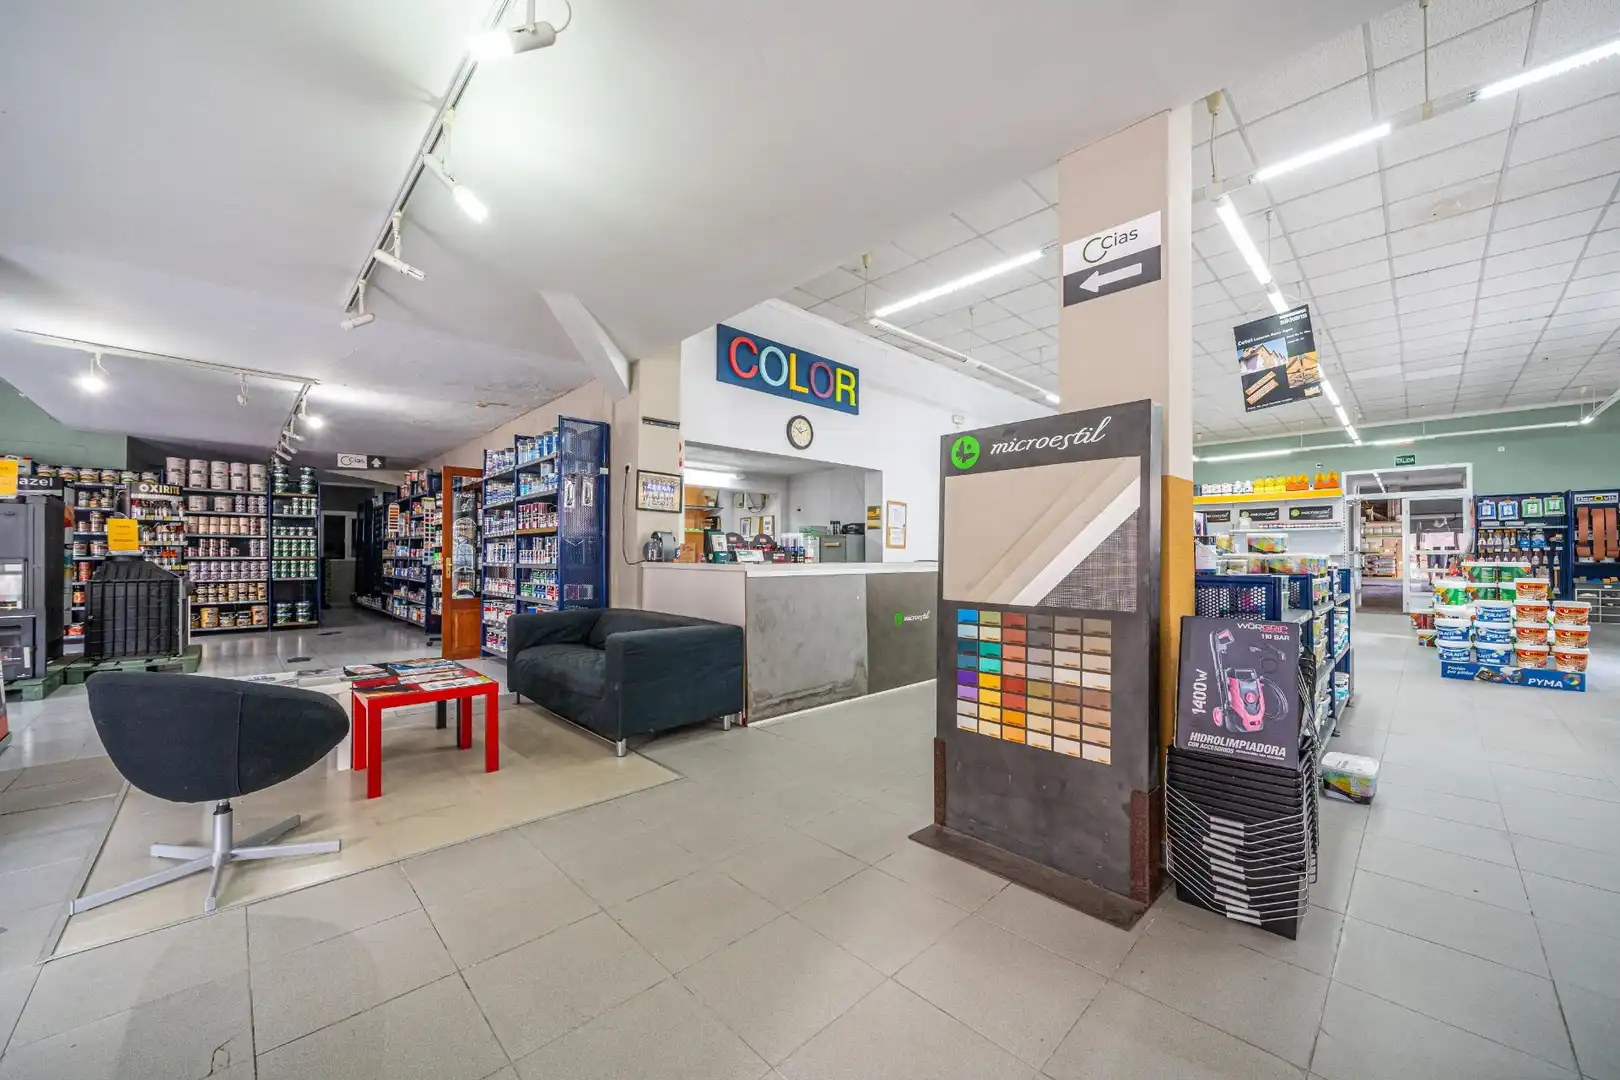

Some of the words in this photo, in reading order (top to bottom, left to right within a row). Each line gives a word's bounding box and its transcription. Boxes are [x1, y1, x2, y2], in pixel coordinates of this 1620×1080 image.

[728, 336, 857, 407] COLOR
[990, 416, 1112, 455] microestil
[16, 477, 53, 487] azel
[139, 483, 180, 495] OXIRITE
[1528, 678, 1563, 688] PYMA
[1189, 731, 1286, 757] HIDROLIMPIADORA
[1200, 743, 1234, 754] ACCESORIOS
